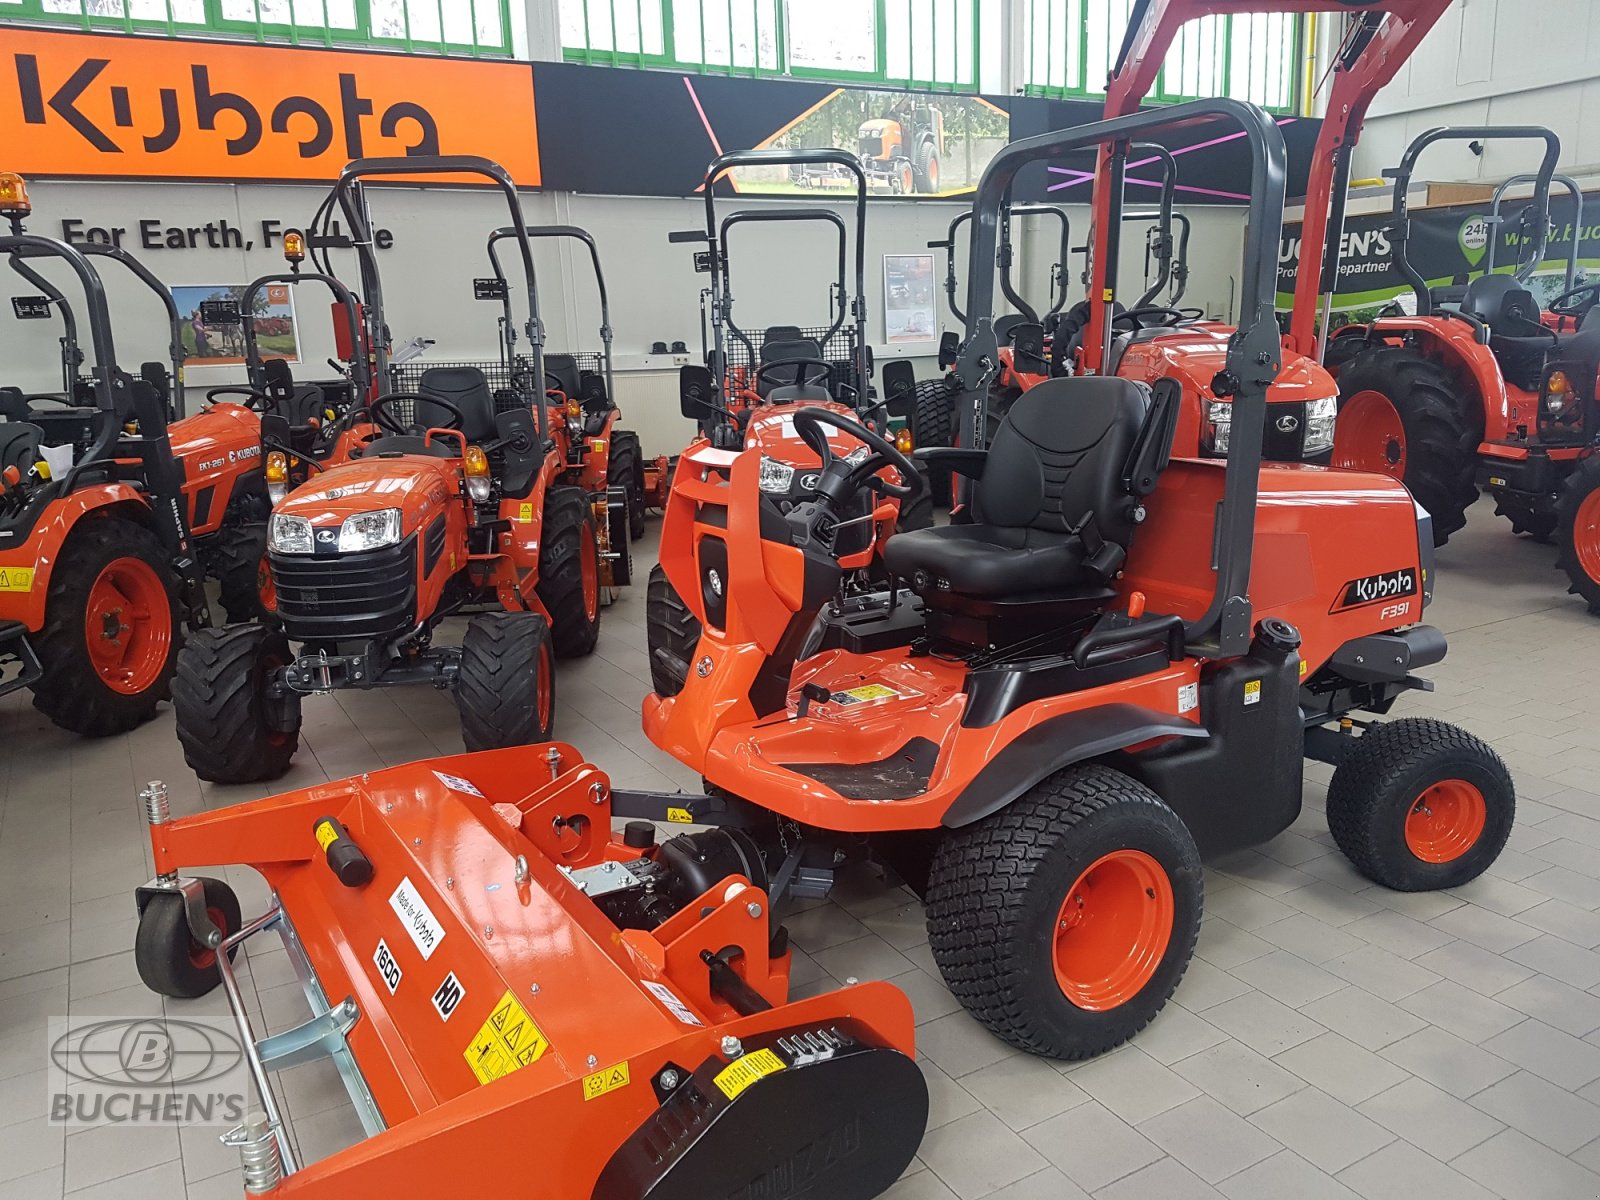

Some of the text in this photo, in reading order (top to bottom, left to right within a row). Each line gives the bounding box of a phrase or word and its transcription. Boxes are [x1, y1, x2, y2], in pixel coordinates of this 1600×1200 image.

[14, 52, 441, 160] Kubota
[139, 218, 254, 252] Earth,
[236, 445, 261, 460] KUBOTA
[1356, 570, 1412, 601] Kubota
[1380, 601, 1410, 620] F391
[396, 888, 434, 949] Made for Kubota
[376, 944, 400, 989] 1600
[434, 974, 461, 1015] HD
